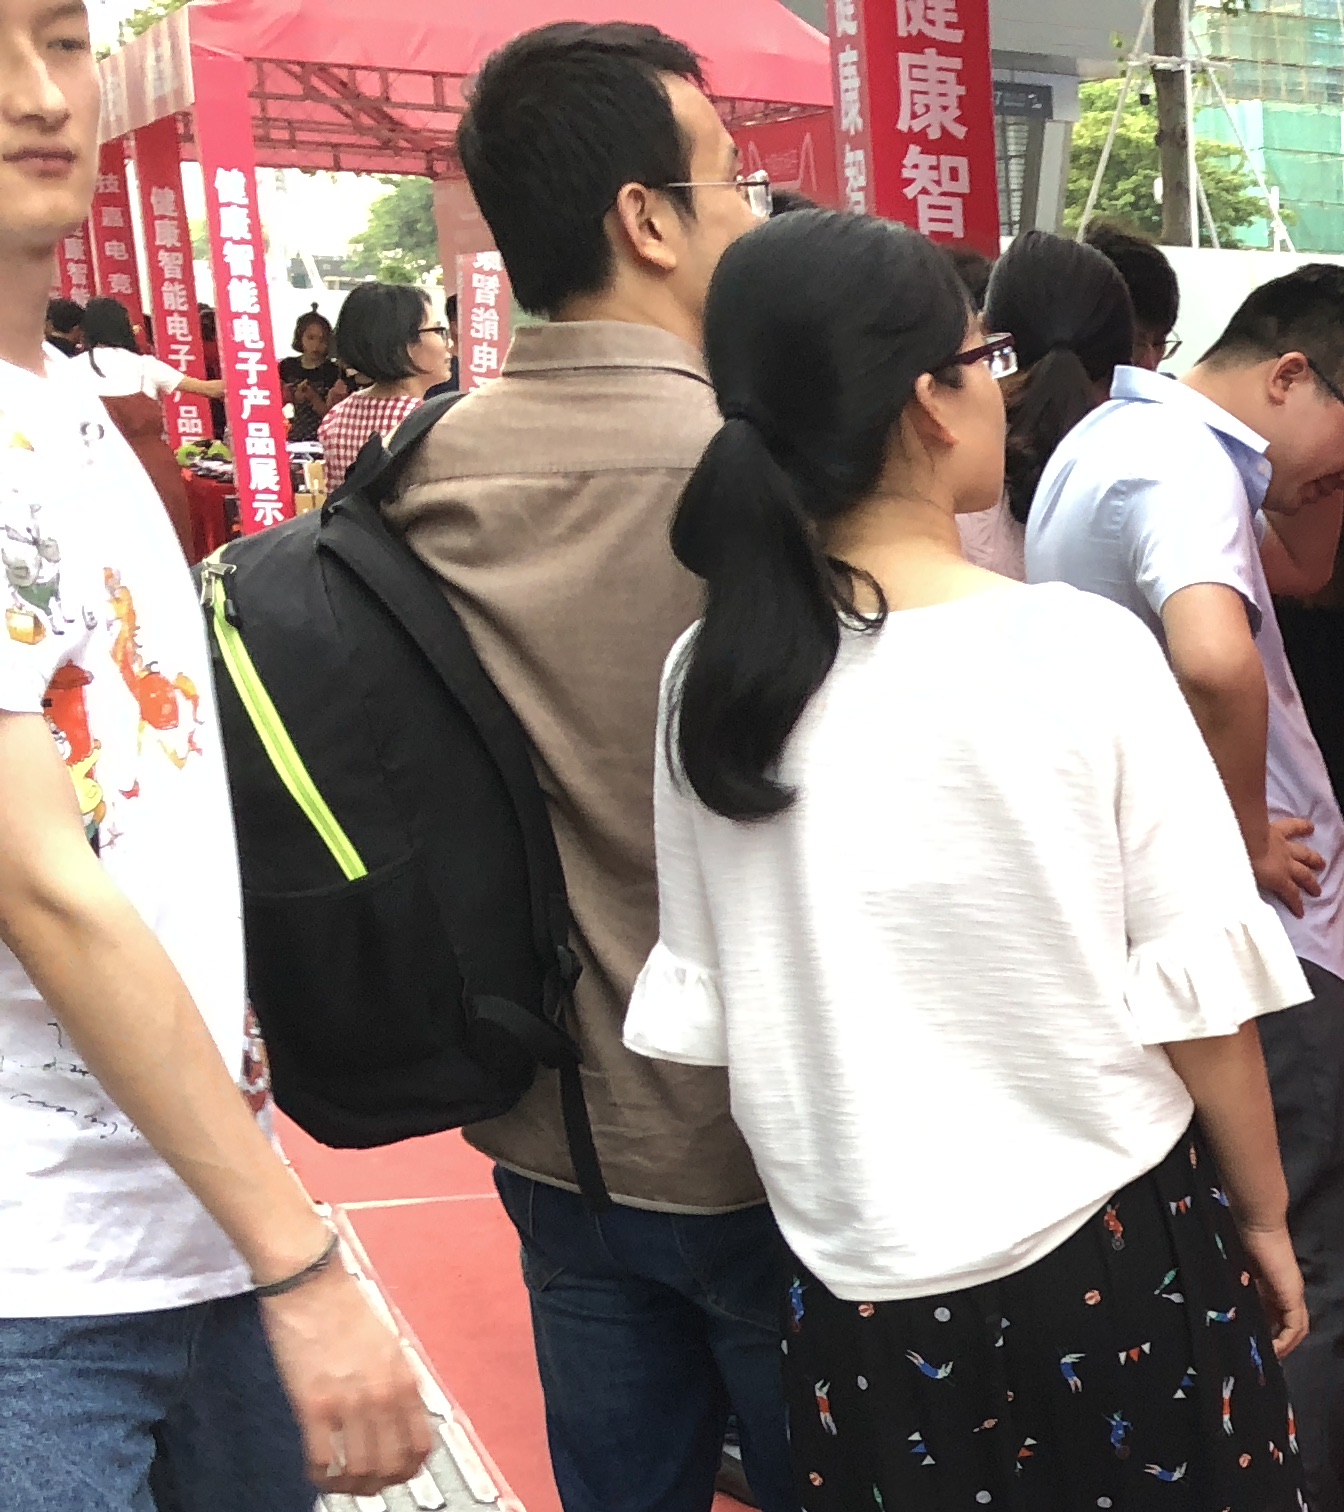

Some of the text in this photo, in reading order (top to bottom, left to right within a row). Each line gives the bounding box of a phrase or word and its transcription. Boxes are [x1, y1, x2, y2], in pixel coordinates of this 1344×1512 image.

[150, 185, 204, 454] 健康智能电子品
[214, 167, 285, 527] 健康智能电子产品展示
